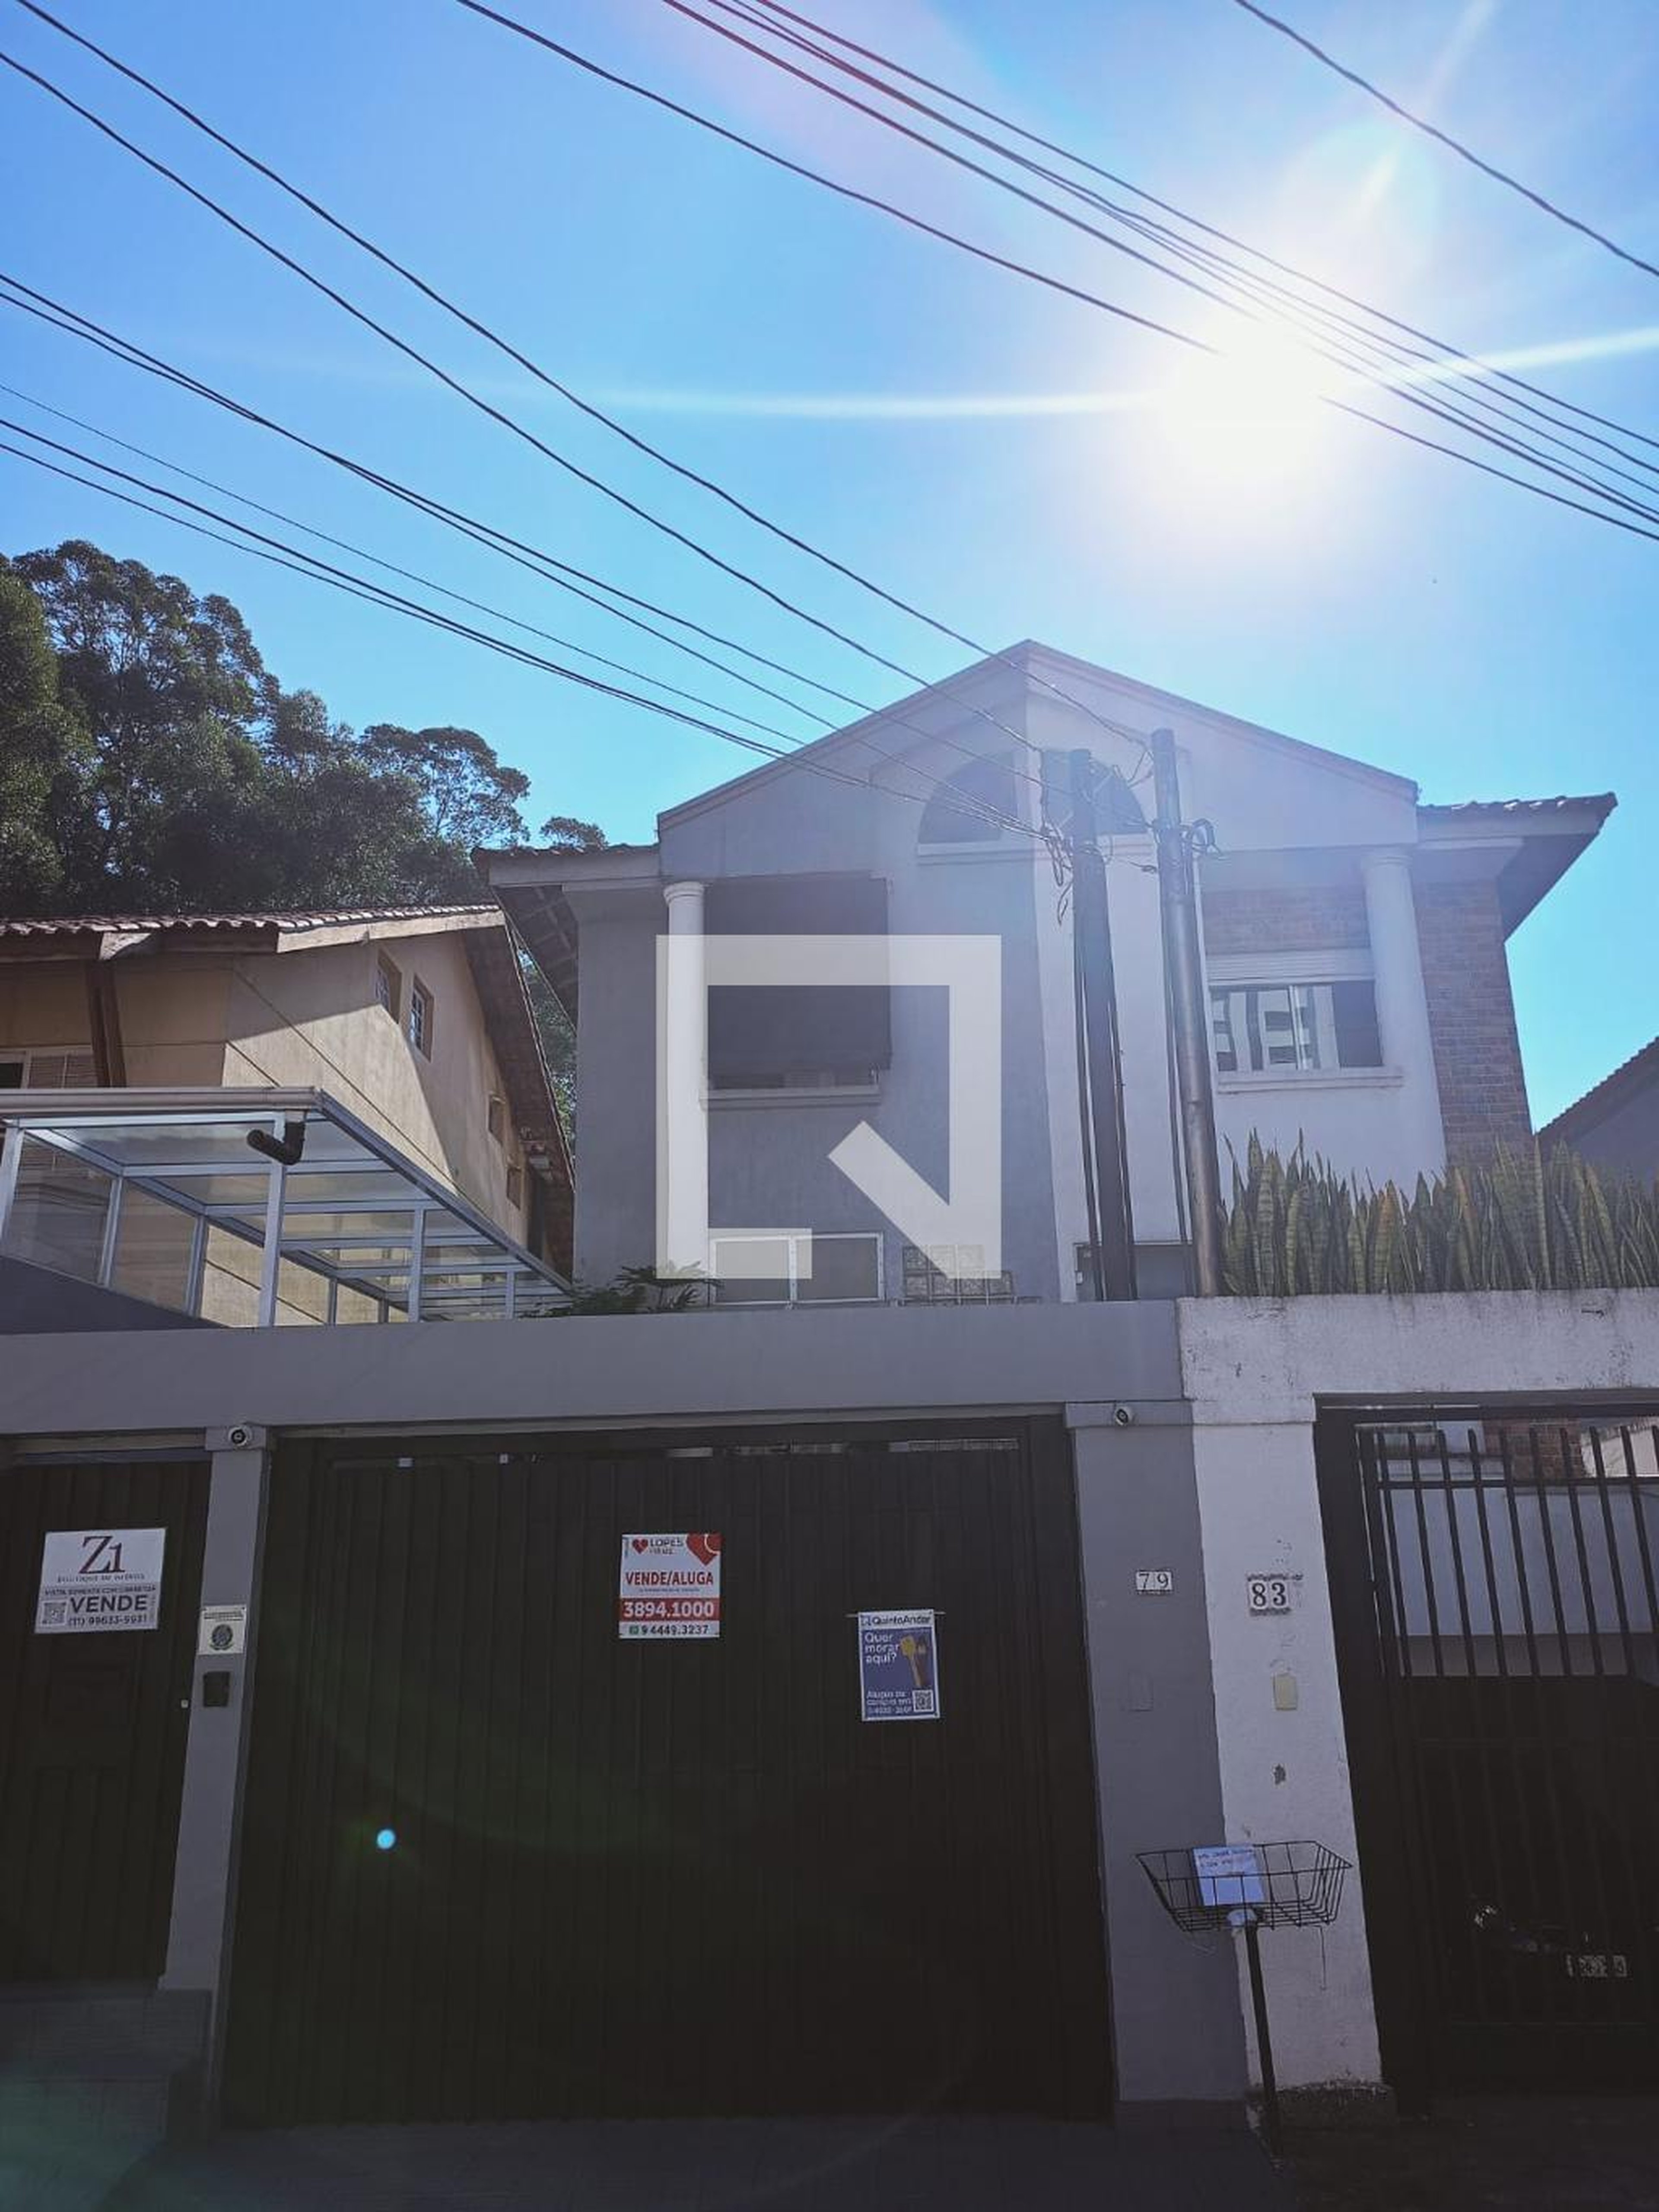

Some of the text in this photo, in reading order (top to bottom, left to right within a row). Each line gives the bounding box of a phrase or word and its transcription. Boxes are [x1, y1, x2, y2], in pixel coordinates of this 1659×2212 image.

[650, 1537, 683, 1547] LOPES
[79, 1535, 126, 1574] Z1
[626, 1571, 713, 1585] VENDE/ALUGA
[1139, 1573, 1169, 1589] 79
[1252, 1582, 1286, 1607] 83
[70, 1595, 147, 1613] VENDE
[624, 1602, 714, 1617] 3894.1000
